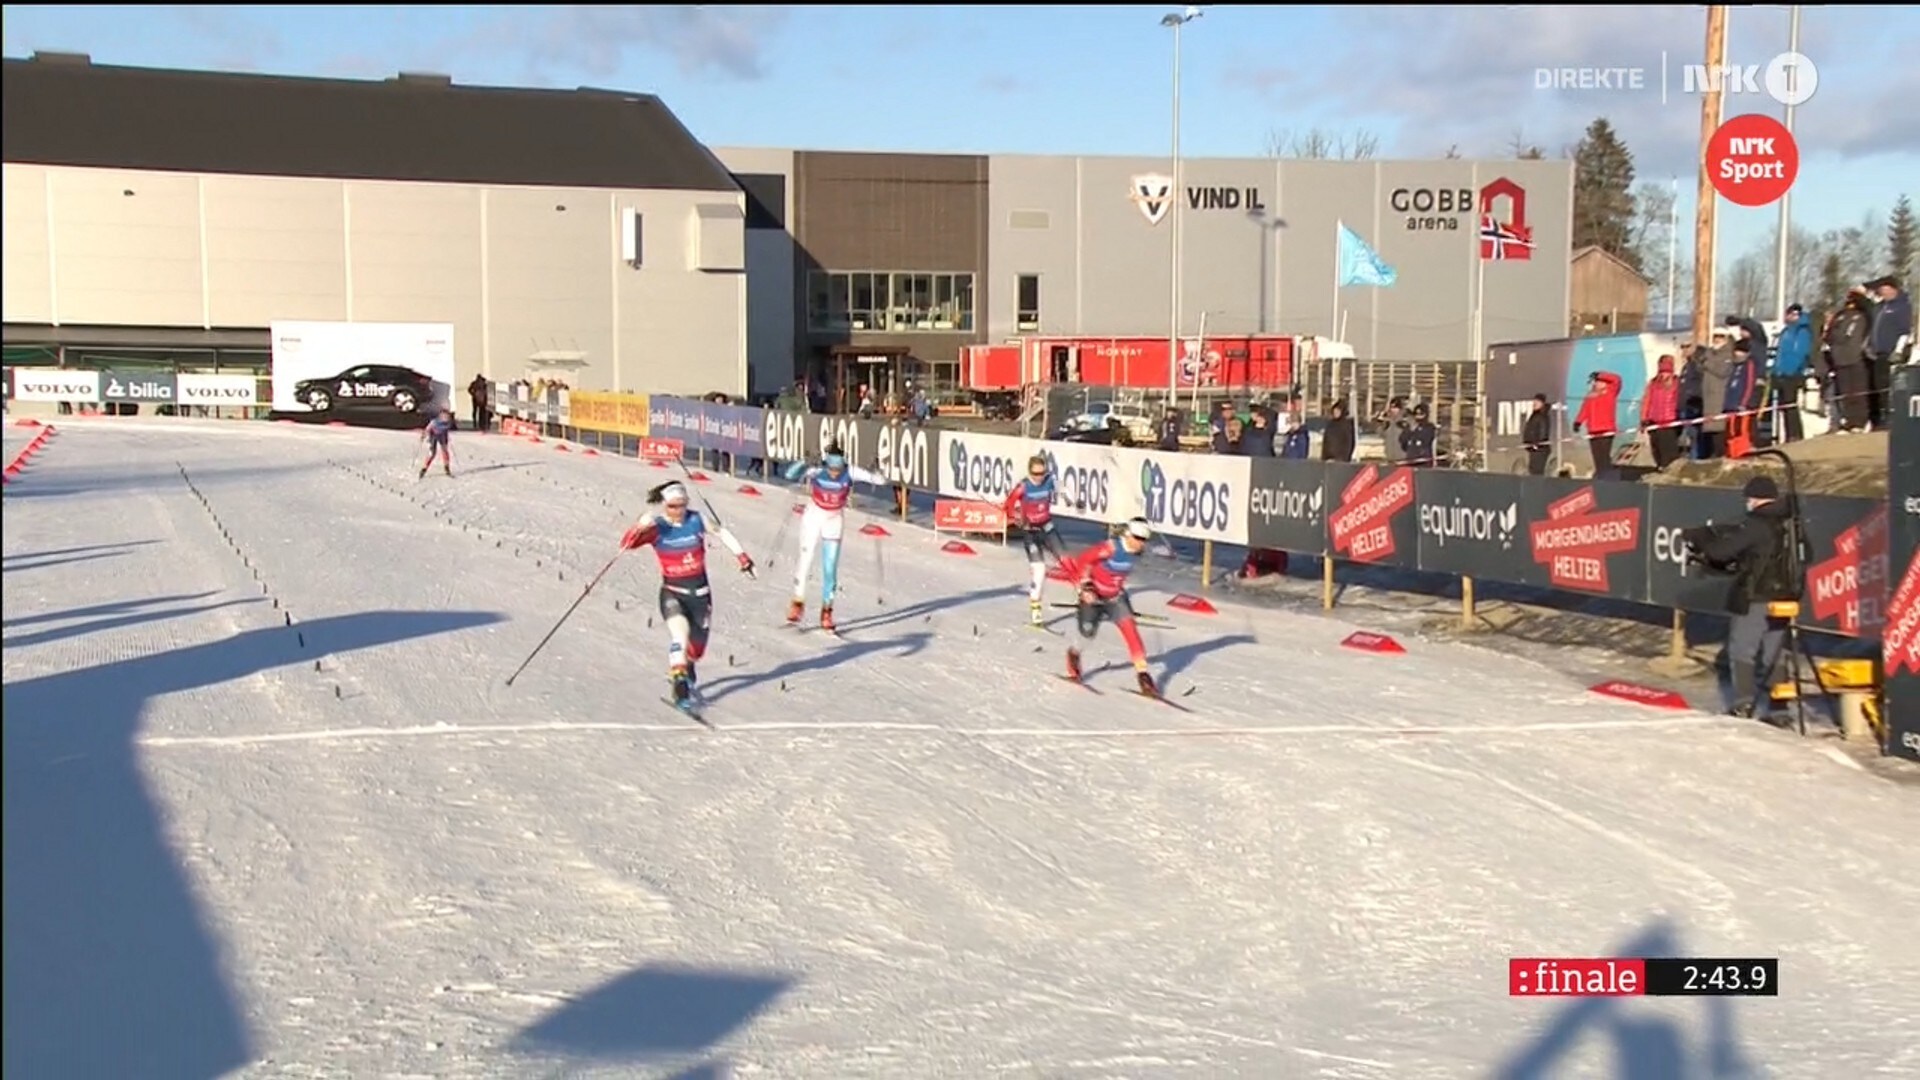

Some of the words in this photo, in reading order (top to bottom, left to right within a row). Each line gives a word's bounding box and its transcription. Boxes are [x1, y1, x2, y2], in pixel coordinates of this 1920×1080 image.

[1187, 187, 1240, 209] VIND
[1246, 188, 1265, 209] IL
[1407, 217, 1458, 230] arena
[23, 383, 93, 395] VOLVO
[129, 382, 172, 398] bilia
[185, 387, 250, 398] VOLVO
[970, 455, 1014, 496] OBOS
[964, 510, 983, 524] 25
[984, 514, 999, 524] m
[1170, 478, 1230, 532] OBOS
[1250, 481, 1306, 525] equinor
[1334, 475, 1409, 537] MORGENDAGENS
[1420, 497, 1497, 547] equinor
[1534, 519, 1633, 550] MORGENDAGENS
[1350, 526, 1390, 557] HELTER
[1553, 555, 1602, 582] HELTER
